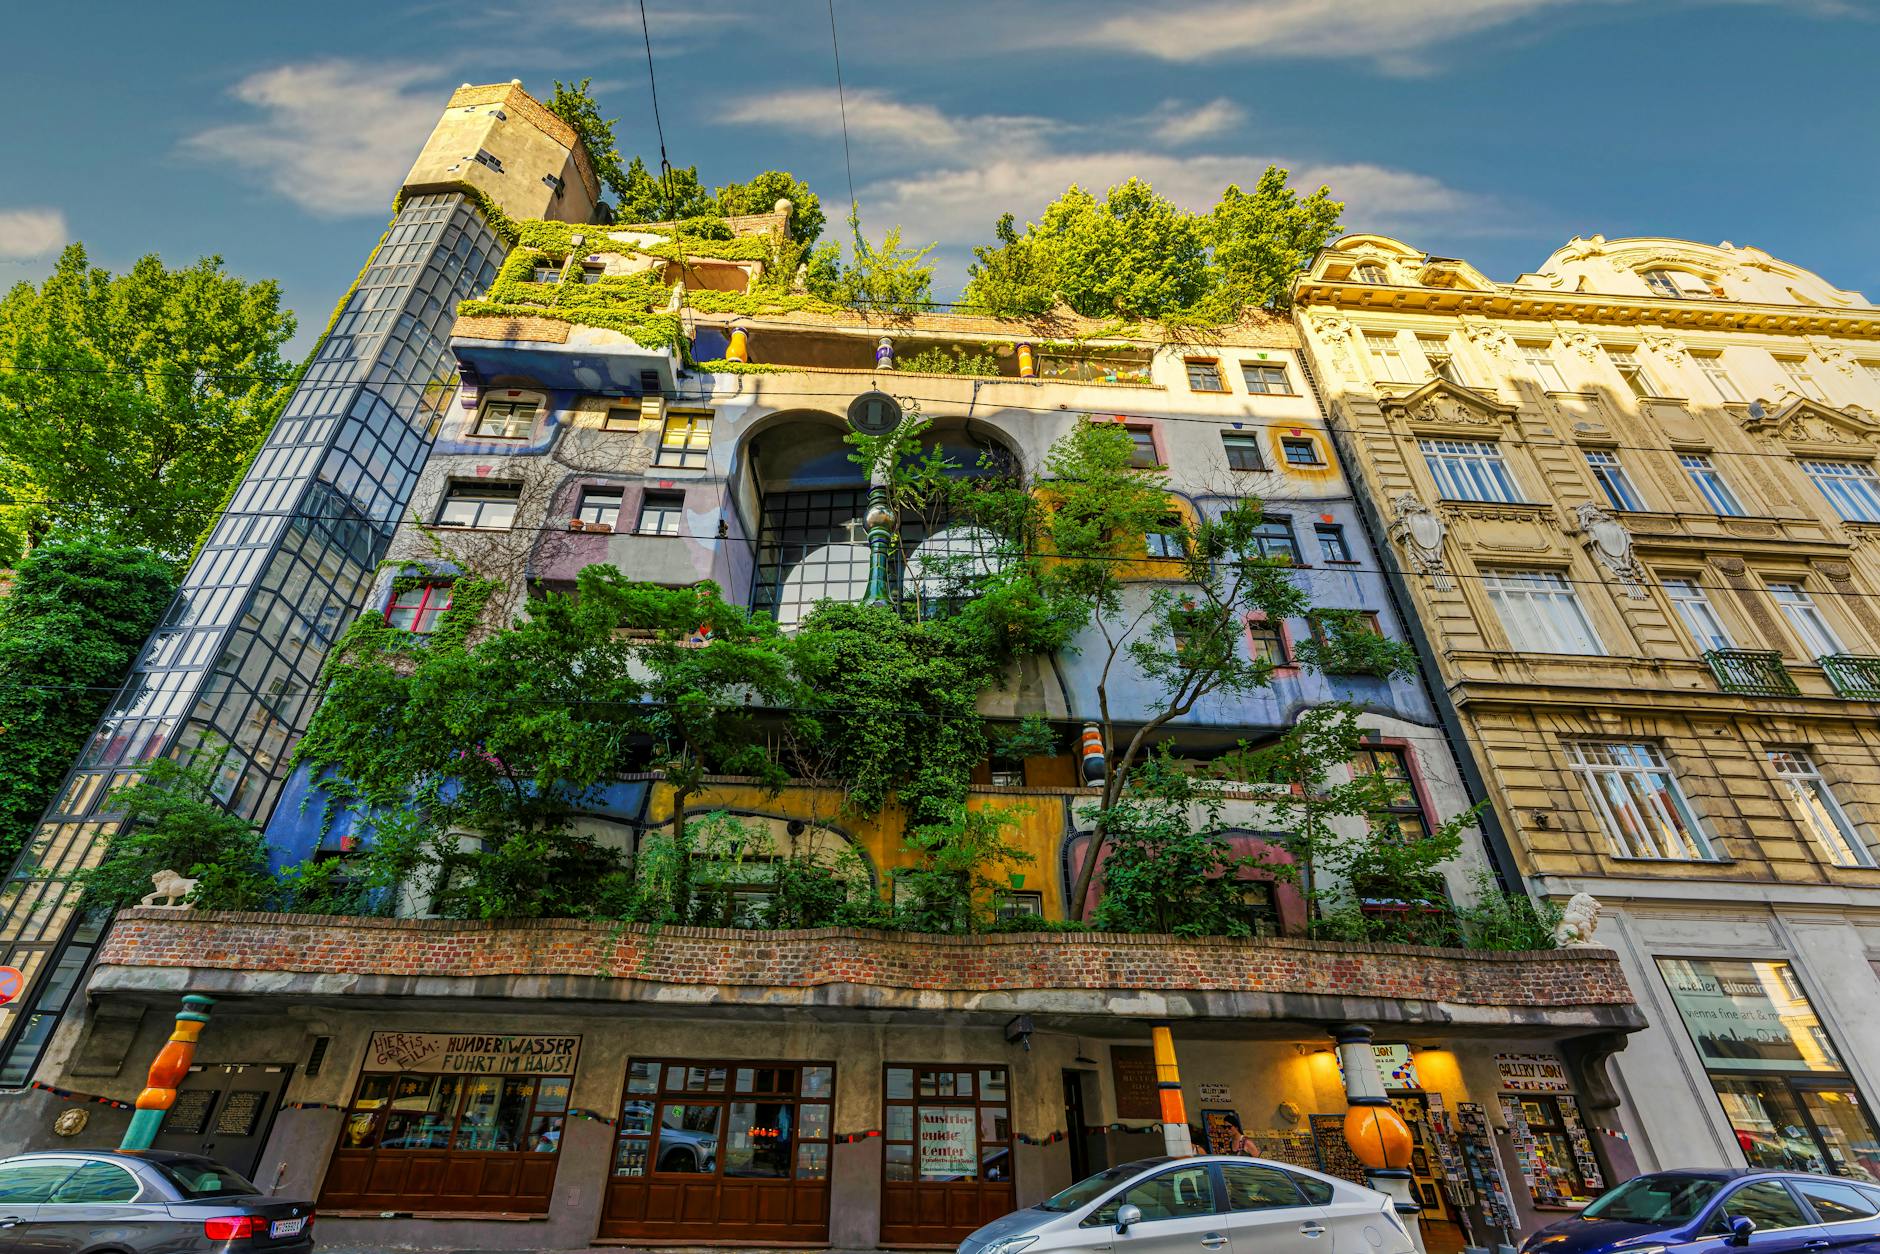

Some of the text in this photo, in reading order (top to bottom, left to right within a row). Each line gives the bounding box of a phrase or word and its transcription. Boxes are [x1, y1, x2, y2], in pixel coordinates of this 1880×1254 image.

[1685, 1009, 1718, 1019] vienna
[1718, 1008, 1739, 1020] fine
[1741, 1011, 1755, 1020] art
[1756, 1009, 1766, 1020] &
[446, 1036, 576, 1055] HUNDERTWASSER
[500, 1056, 519, 1072] IM
[525, 1055, 572, 1073] HAUS!
[1499, 1063, 1563, 1078] GALLERY LION
